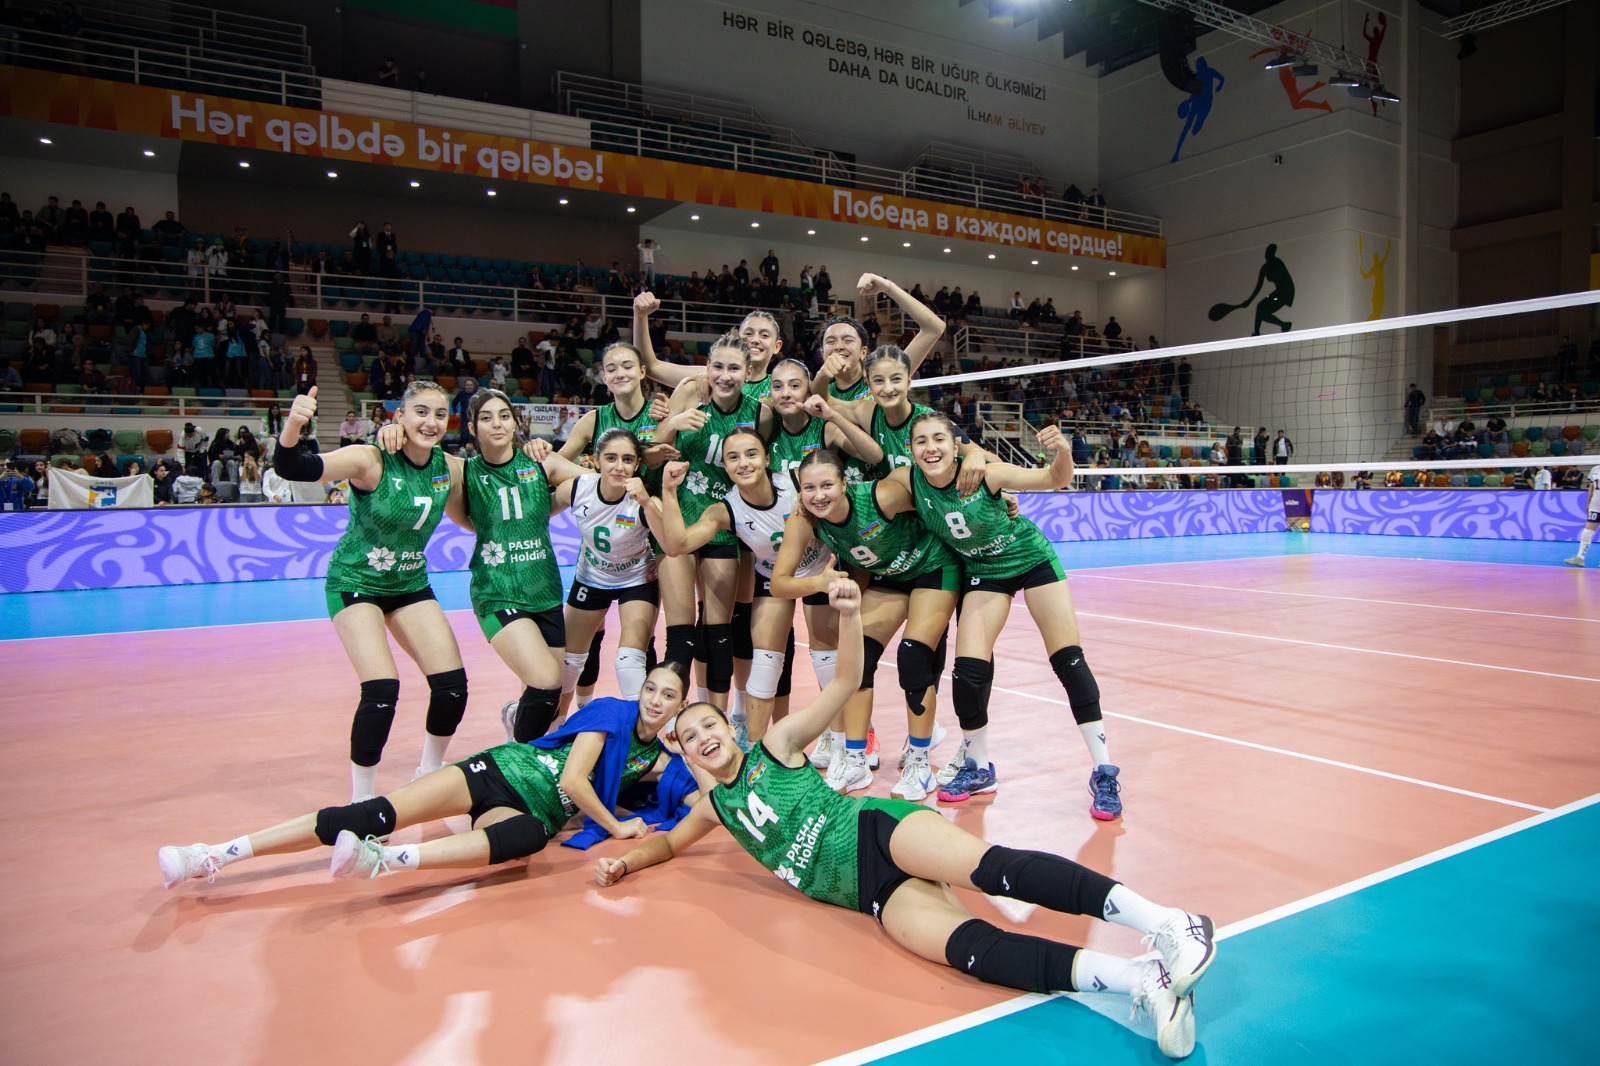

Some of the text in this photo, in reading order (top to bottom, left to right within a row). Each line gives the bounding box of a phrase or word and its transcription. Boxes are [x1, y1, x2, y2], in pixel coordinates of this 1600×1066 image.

[723, 11, 1046, 101] HƏR BİR QƏLƏBƏ, HƏR BİR UĞUR ÖLKƏMİZİ
[829, 58, 969, 102] DAHA DA UCALDIR.
[967, 105, 1046, 136] İLHAM ƏLİYEV
[171, 95, 604, 183] Hər qəlbdə bir qələbə!
[833, 189, 1123, 257] Победа в каждом сердце!
[413, 496, 433, 530] 7
[498, 485, 523, 520] 11
[593, 525, 611, 553] 6
[944, 511, 972, 539] 8
[398, 561, 424, 572] Hold
[401, 551, 423, 561] PAS
[850, 545, 882, 568] 9
[576, 586, 589, 602] 6
[468, 760, 487, 773] 3
[736, 790, 780, 843] 14
[786, 816, 815, 862] PASHA
[795, 813, 828, 870] Holding
